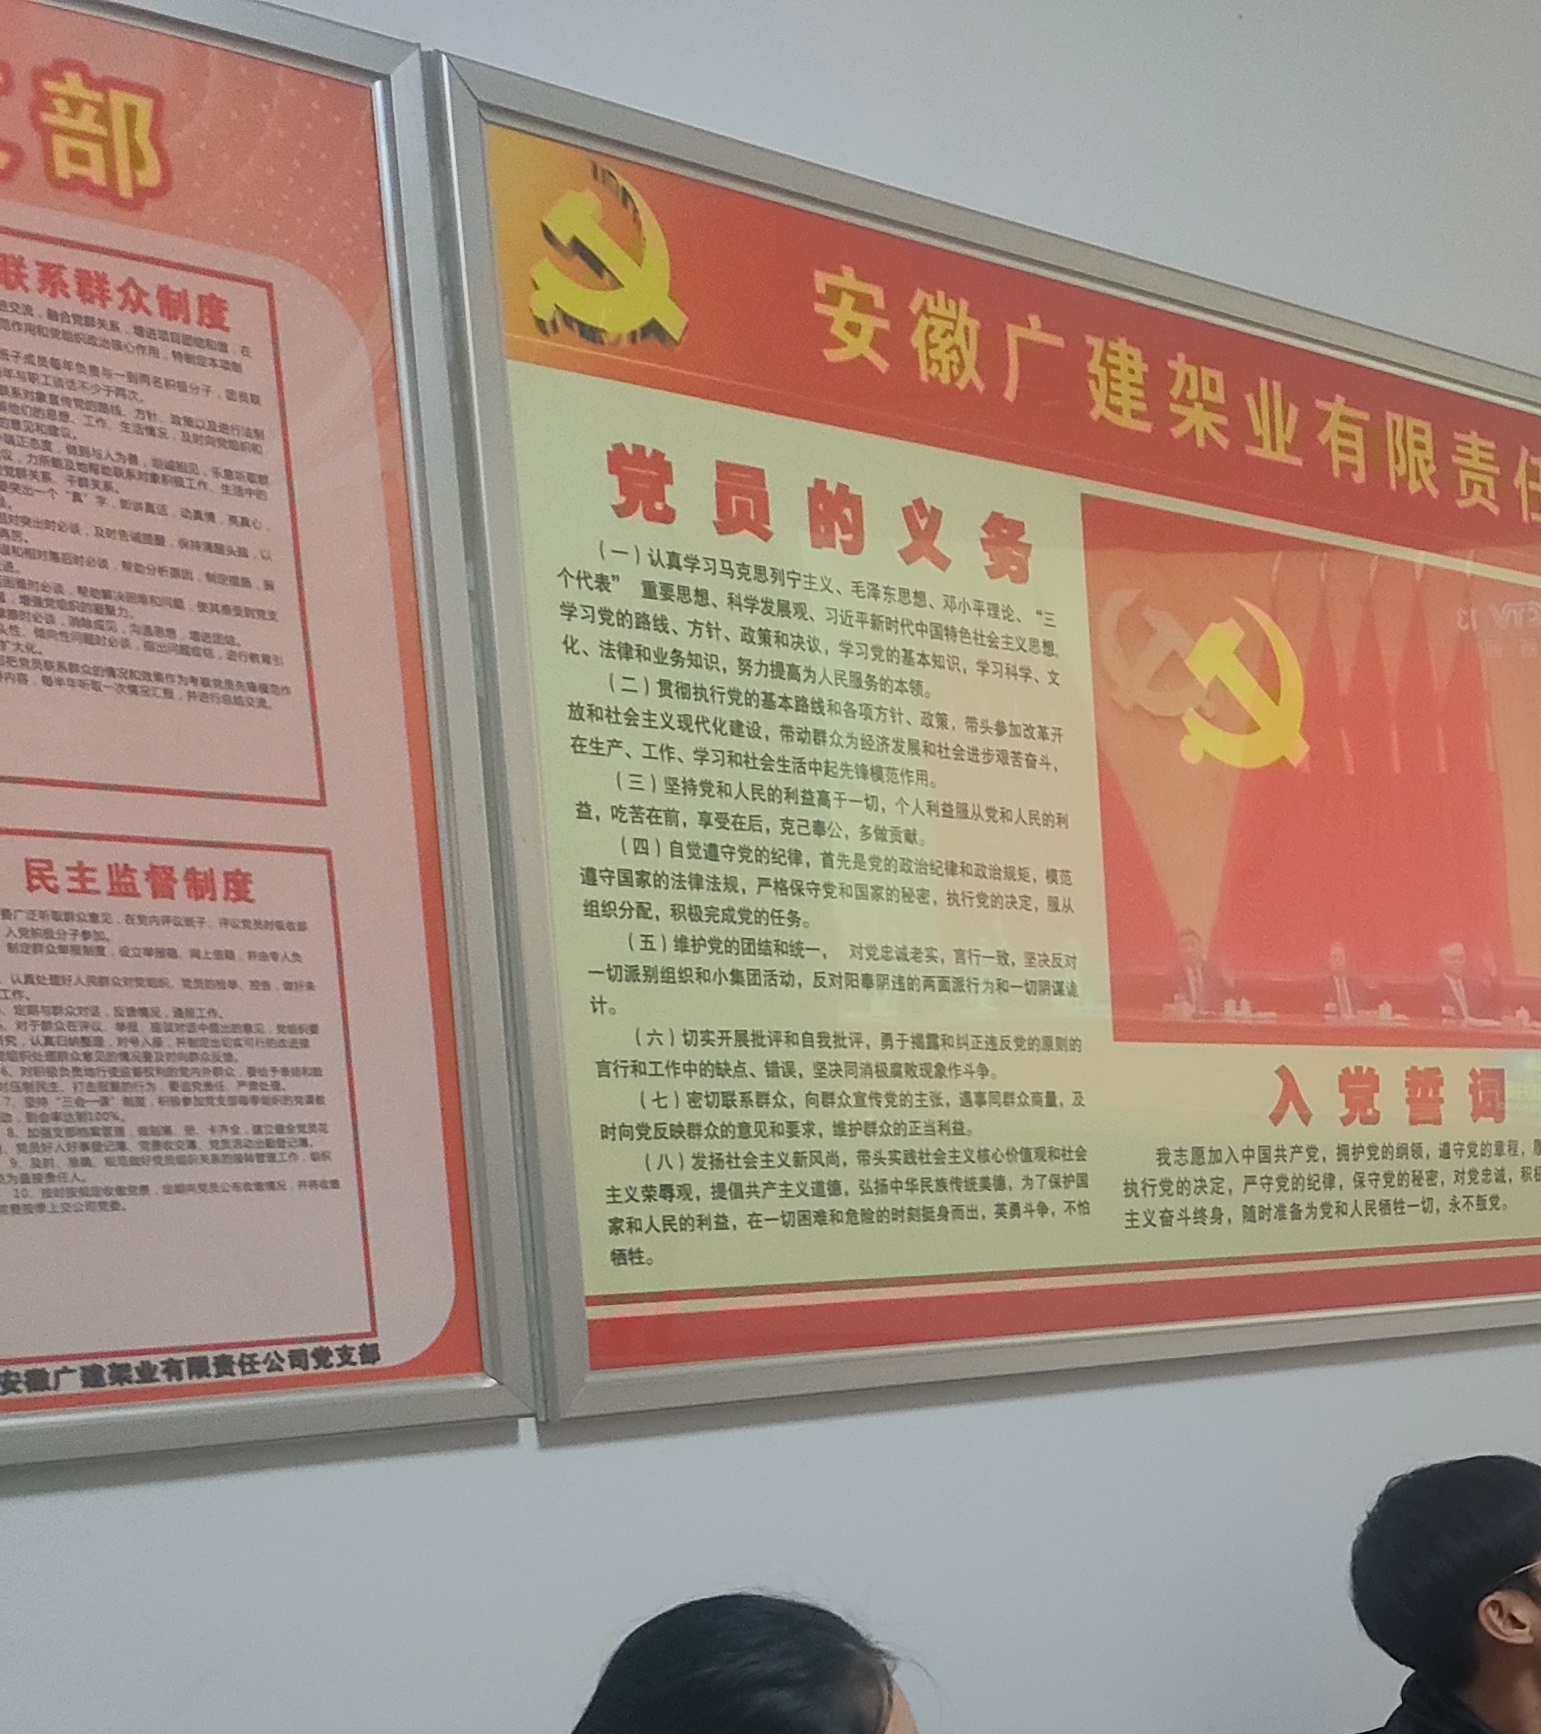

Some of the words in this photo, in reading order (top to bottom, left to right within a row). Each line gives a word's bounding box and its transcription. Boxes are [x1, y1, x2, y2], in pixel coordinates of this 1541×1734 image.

[0, 70, 163, 200] 部
[0, 253, 231, 332] 联系群众制度
[606, 442, 1032, 585] 党员的义务
[24, 857, 256, 904] 民主监督制度
[589, 994, 617, 1016] 计。
[1268, 1065, 1506, 1127] 入党誓词
[609, 1246, 654, 1268] 牺牲。
[0, 1343, 381, 1394] 安徽广建架业有限责任公司党支部
